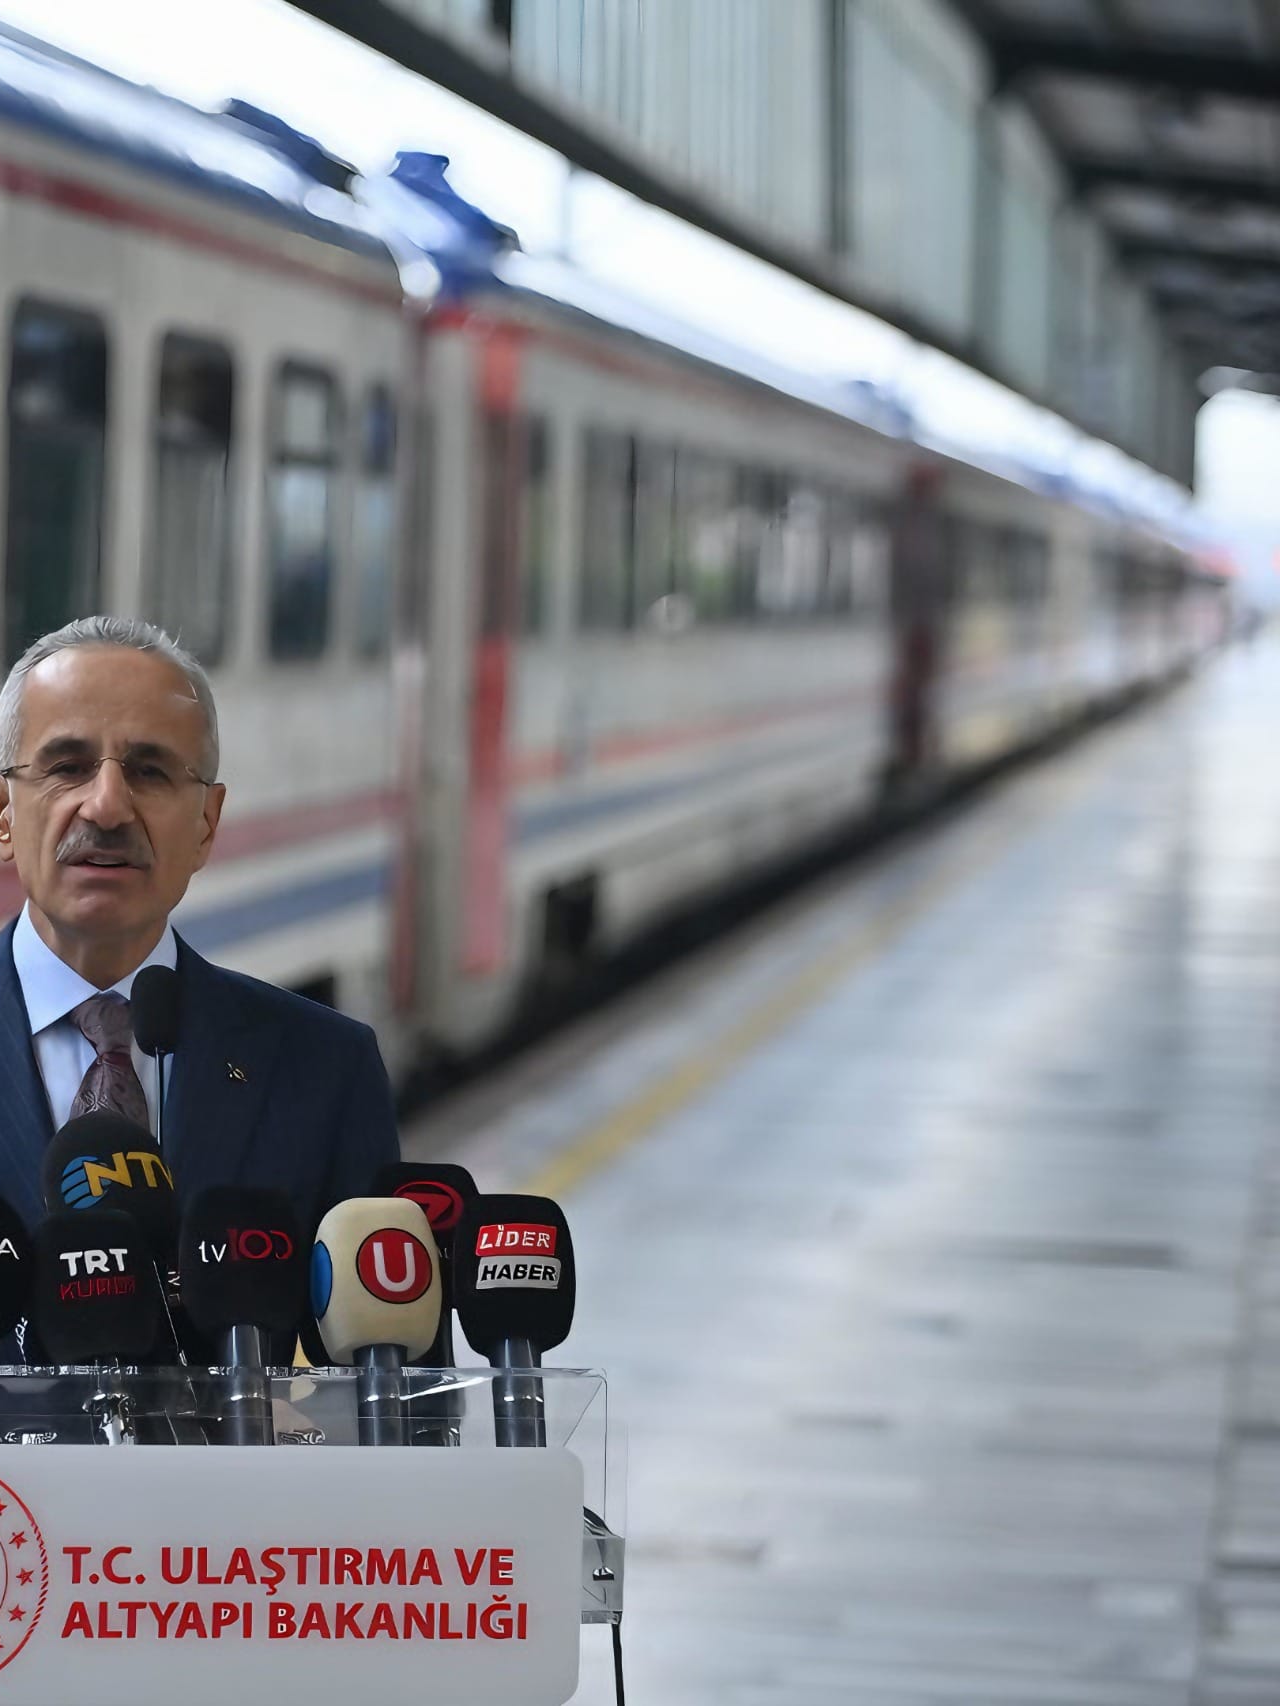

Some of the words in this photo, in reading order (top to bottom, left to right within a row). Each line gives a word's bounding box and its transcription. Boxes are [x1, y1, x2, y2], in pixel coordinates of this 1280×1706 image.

[83, 1151, 174, 1198] NTV
[479, 1224, 551, 1250] LİDER
[59, 1248, 128, 1277] TRT
[373, 1241, 416, 1292] U
[480, 1263, 557, 1281] HABER
[62, 1546, 146, 1585] T.C.
[160, 1546, 443, 1596] ULAŞTIRMA
[453, 1547, 515, 1586] VE
[60, 1601, 253, 1640] ALTYAPI
[267, 1594, 528, 1640] BAKANLIĞI
